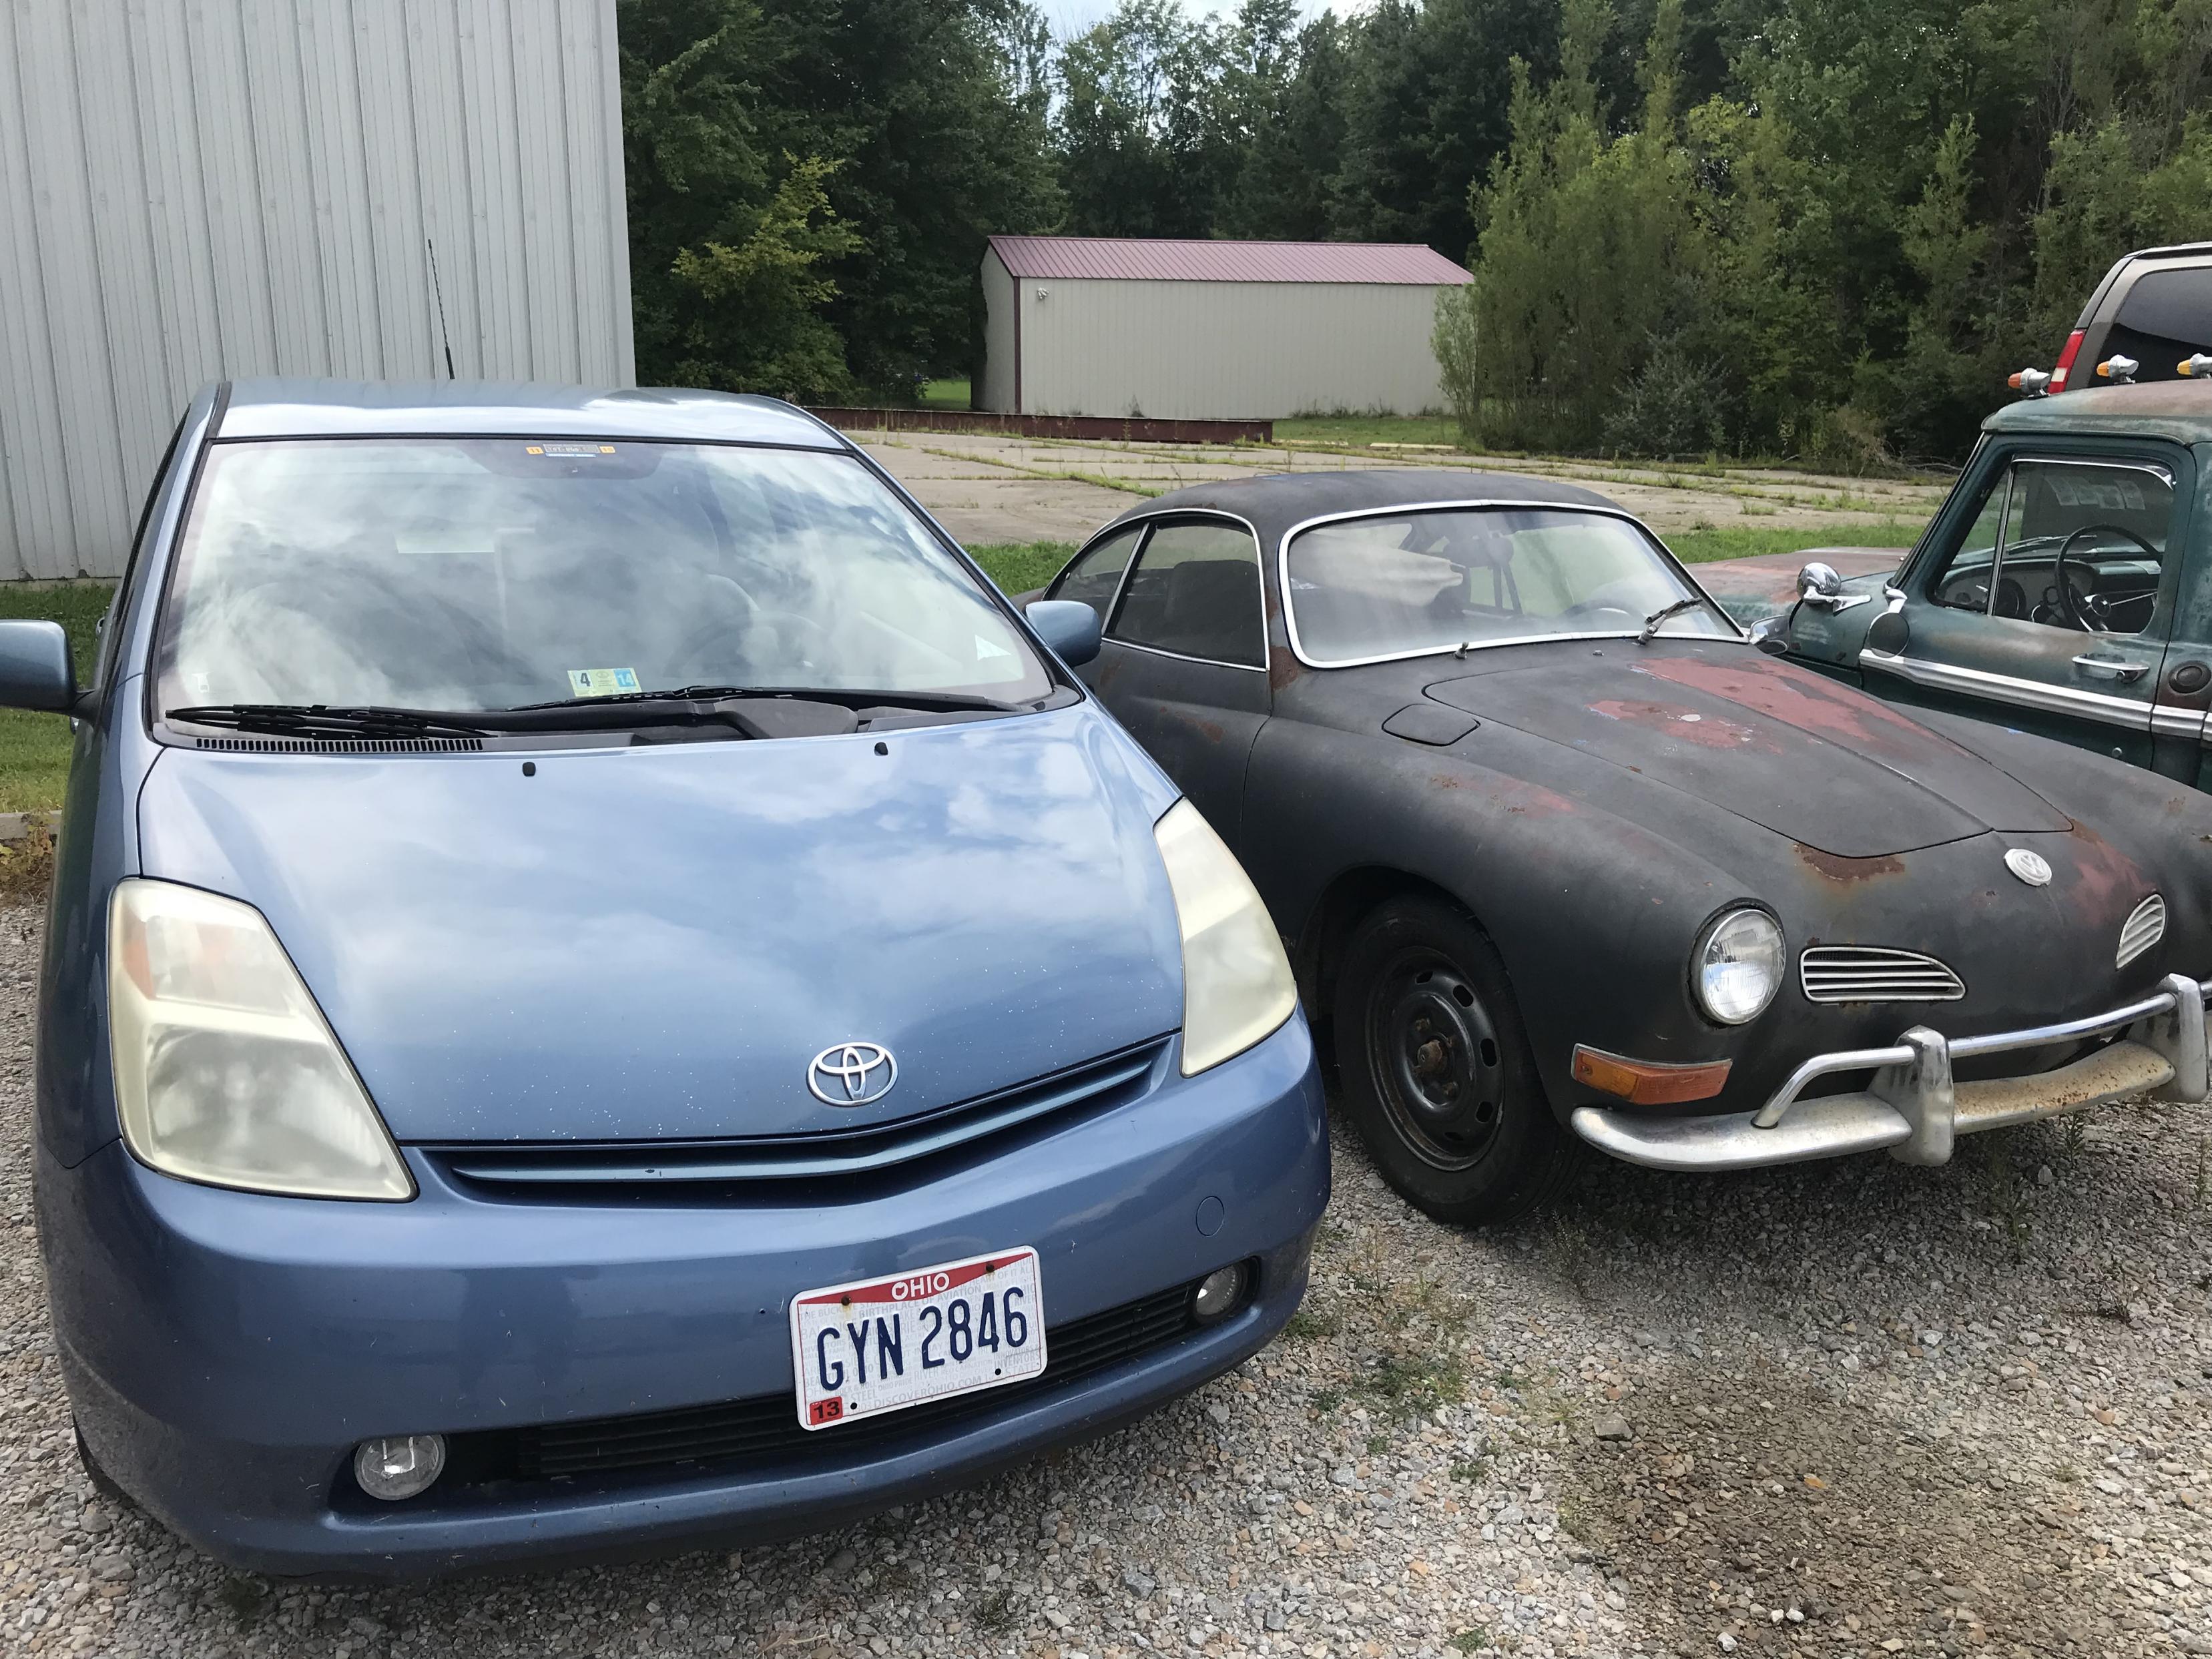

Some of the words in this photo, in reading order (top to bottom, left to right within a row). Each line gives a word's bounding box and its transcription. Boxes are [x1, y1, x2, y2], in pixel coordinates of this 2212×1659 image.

[580, 672, 591, 687] 4
[617, 672, 634, 686] 14
[892, 1273, 950, 1301] OHIO
[859, 1301, 918, 1319] BIRTHPLACE
[936, 1285, 981, 1303] AVIATION
[817, 1313, 904, 1391] GYN
[918, 1287, 1027, 1369] 2846
[994, 1352, 1040, 1369] INVENTORS
[814, 1401, 840, 1419] 13
